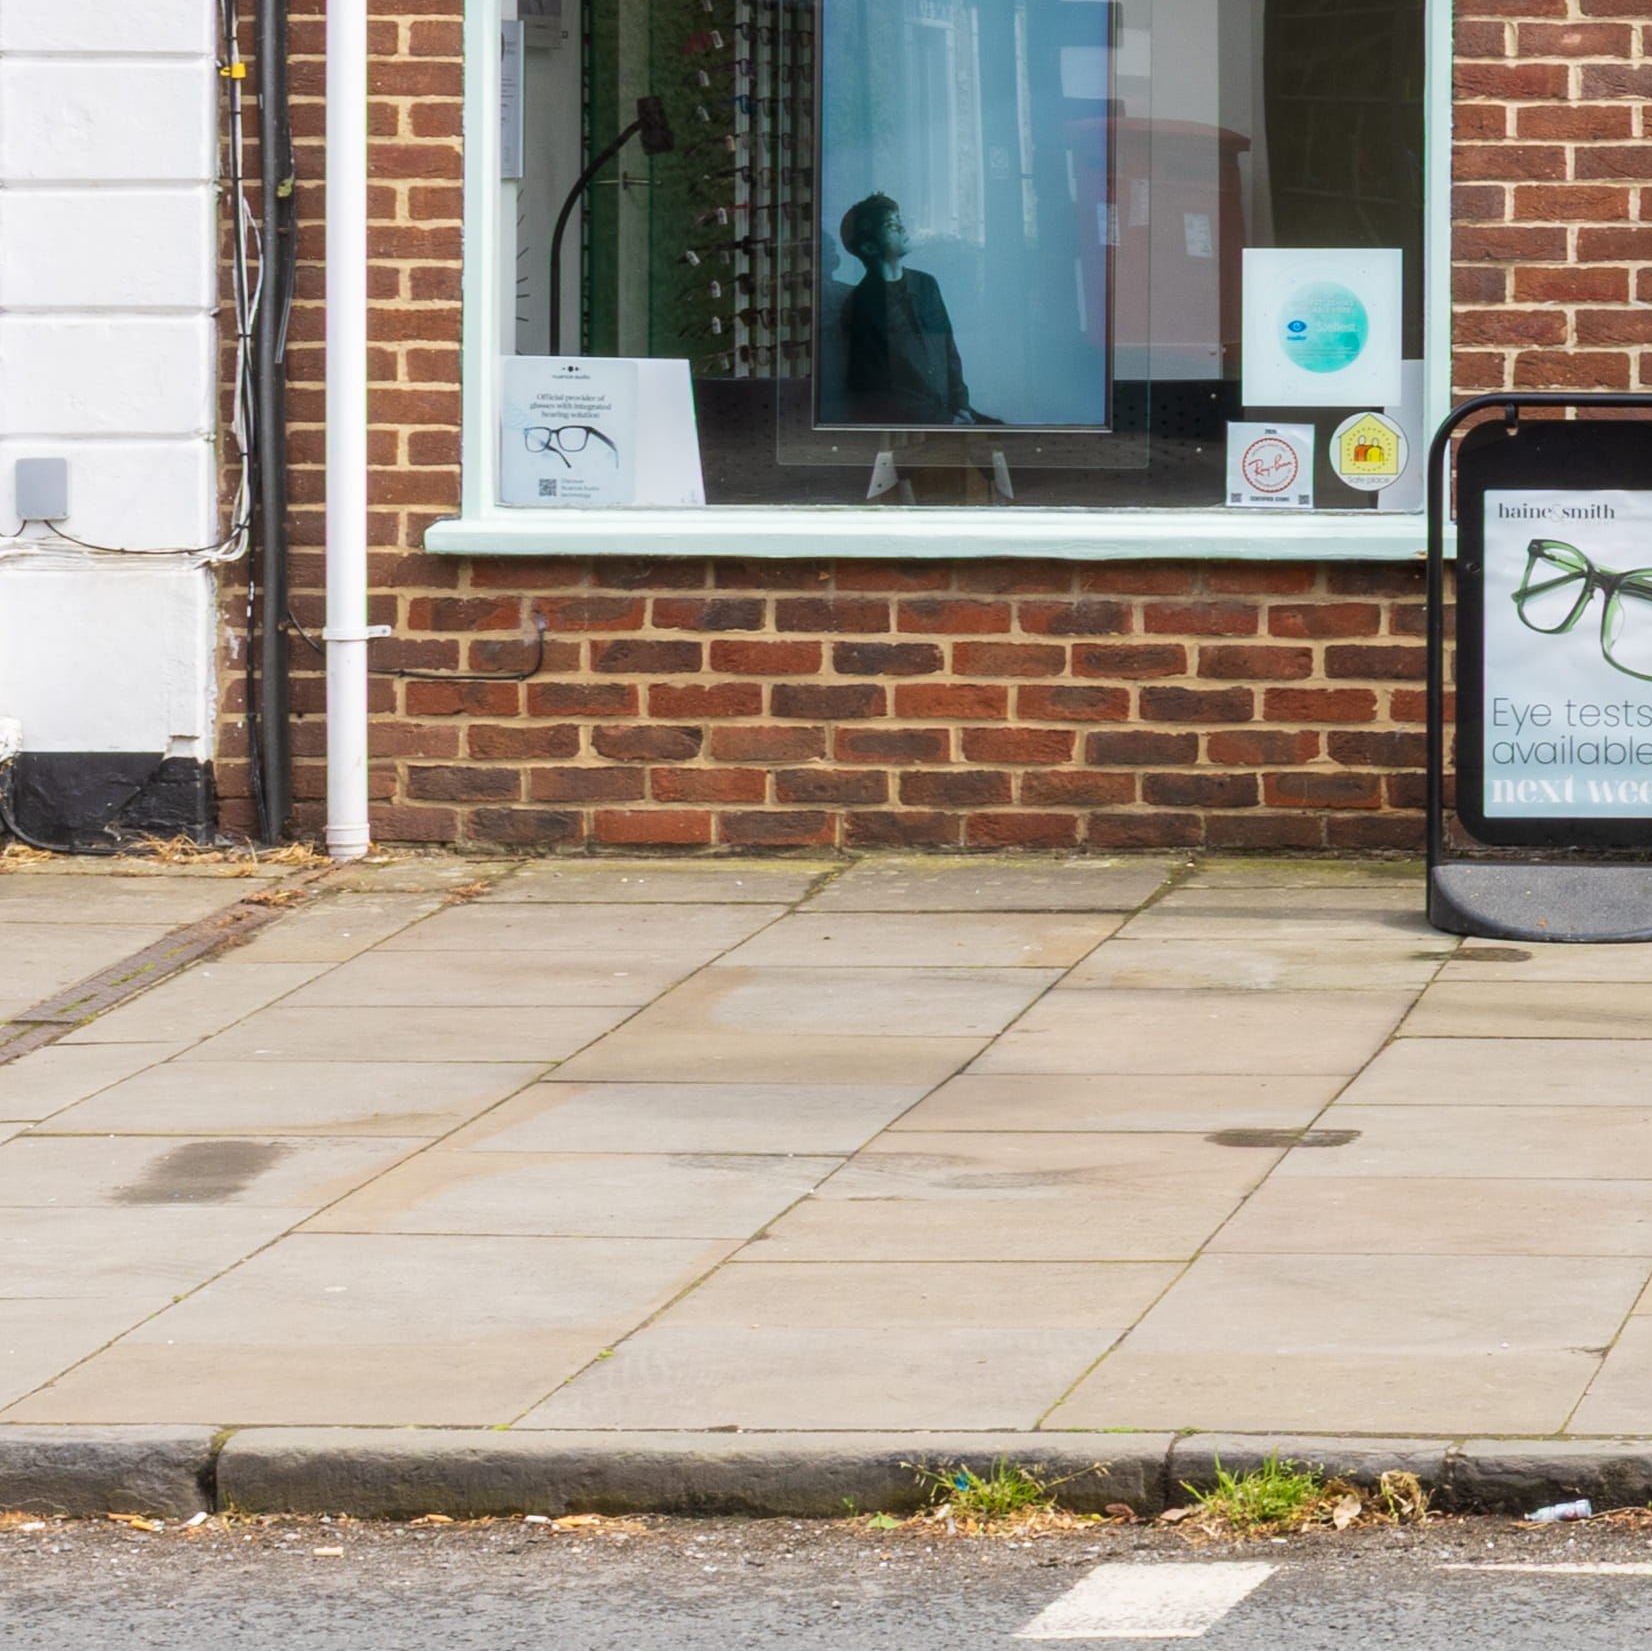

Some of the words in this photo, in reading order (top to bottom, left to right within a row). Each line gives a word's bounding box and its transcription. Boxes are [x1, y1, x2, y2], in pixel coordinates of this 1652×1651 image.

[536, 393, 564, 401] Official
[565, 394, 599, 402] provider
[556, 402, 573, 410] with
[574, 403, 612, 411] integrated
[541, 411, 569, 419] hearing
[1248, 454, 1293, 477] Ray-Ban
[1349, 475, 1365, 484] Safe
[1365, 476, 1390, 485] place
[1498, 502, 1616, 523] haine&smith
[1493, 697, 1552, 736] Eye
[1491, 773, 1577, 804] next
